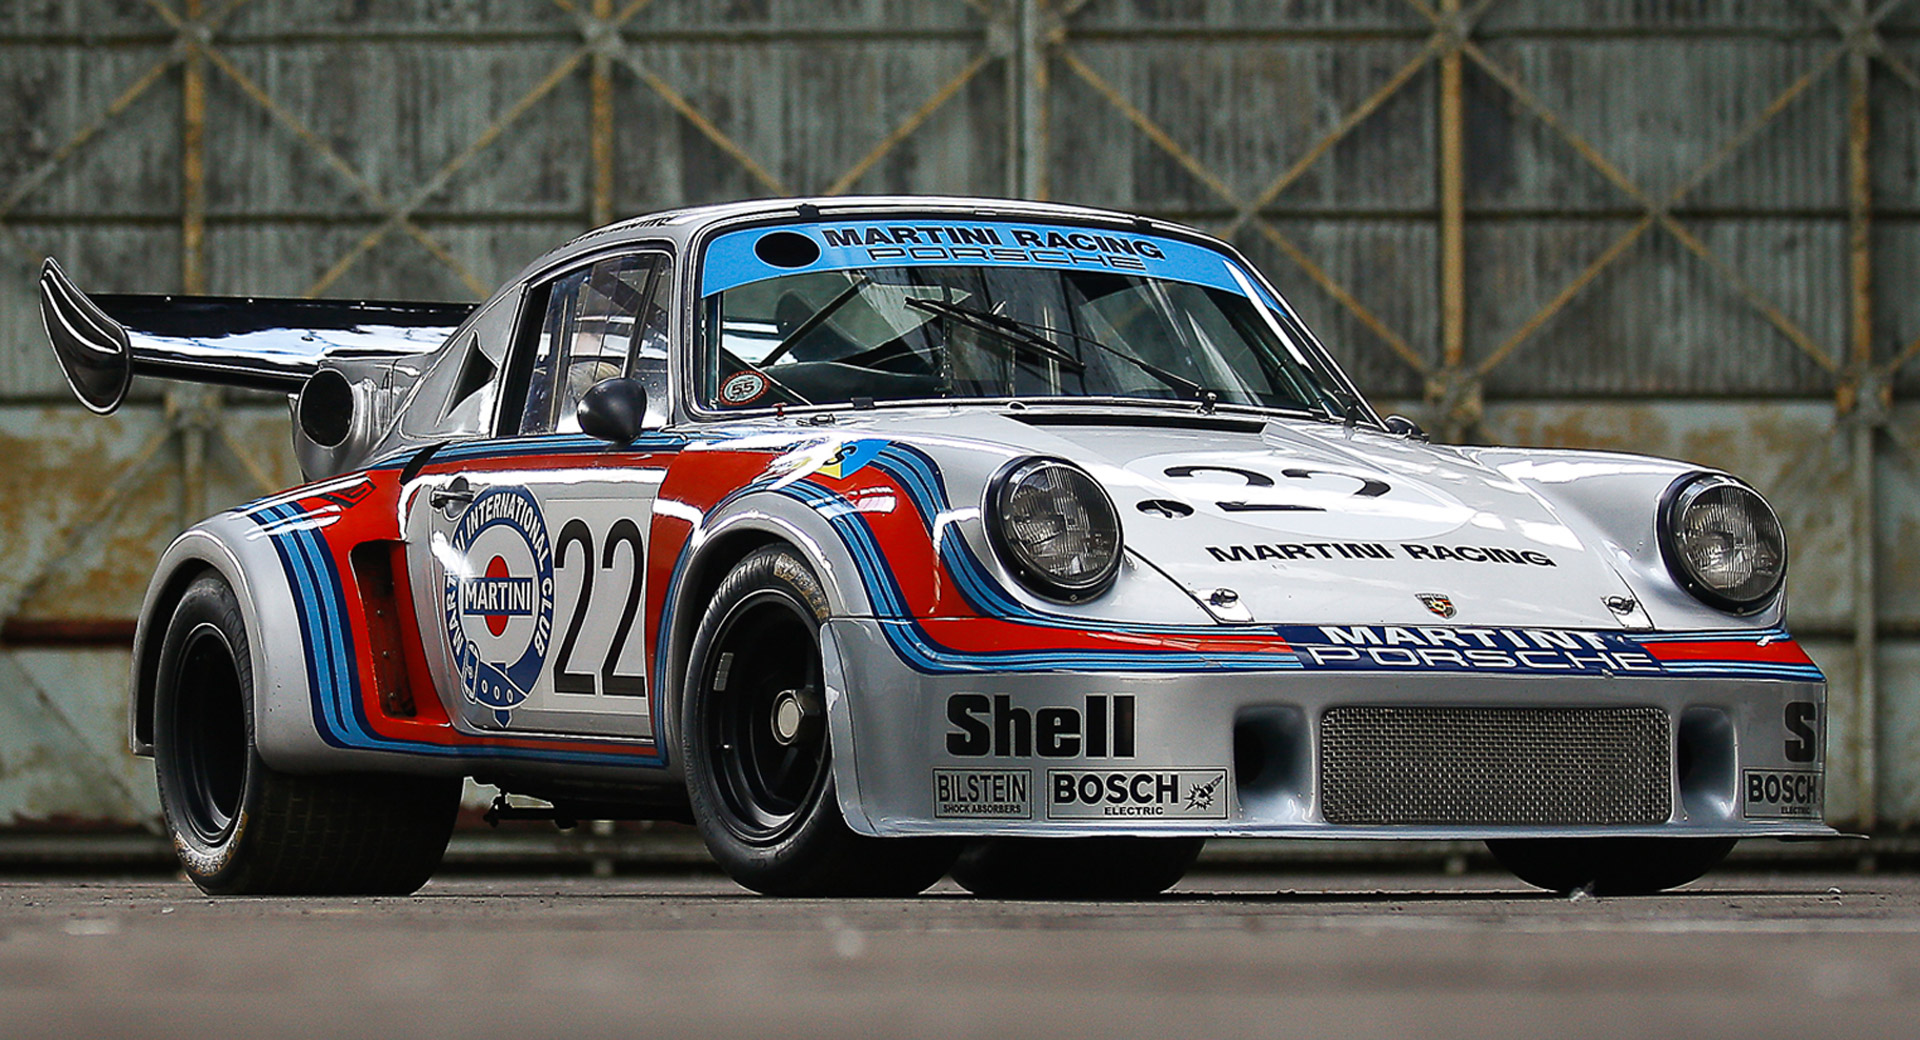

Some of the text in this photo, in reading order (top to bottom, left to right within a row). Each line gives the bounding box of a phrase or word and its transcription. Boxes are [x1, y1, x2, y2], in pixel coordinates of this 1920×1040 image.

[821, 227, 1165, 260] MARTINI RACING
[867, 247, 1146, 271] PORSCHE
[1205, 543, 1557, 567] MARTINI RACING
[466, 492, 549, 572] INTERNATIONAL
[534, 577, 553, 657] CLUB
[465, 582, 531, 611] MARTINI
[554, 518, 646, 697] 22
[1318, 626, 1608, 650] MARTINI
[1306, 647, 1661, 671] PORSCHE
[946, 693, 1136, 758] Shell
[938, 775, 1026, 802] BILSTEIN
[1053, 774, 1179, 804] BOSCH
[1748, 774, 1817, 804] BOSCH
[943, 804, 1021, 813] SHOCK ABSORBERS
[1104, 806, 1163, 816] ELECTRIC
